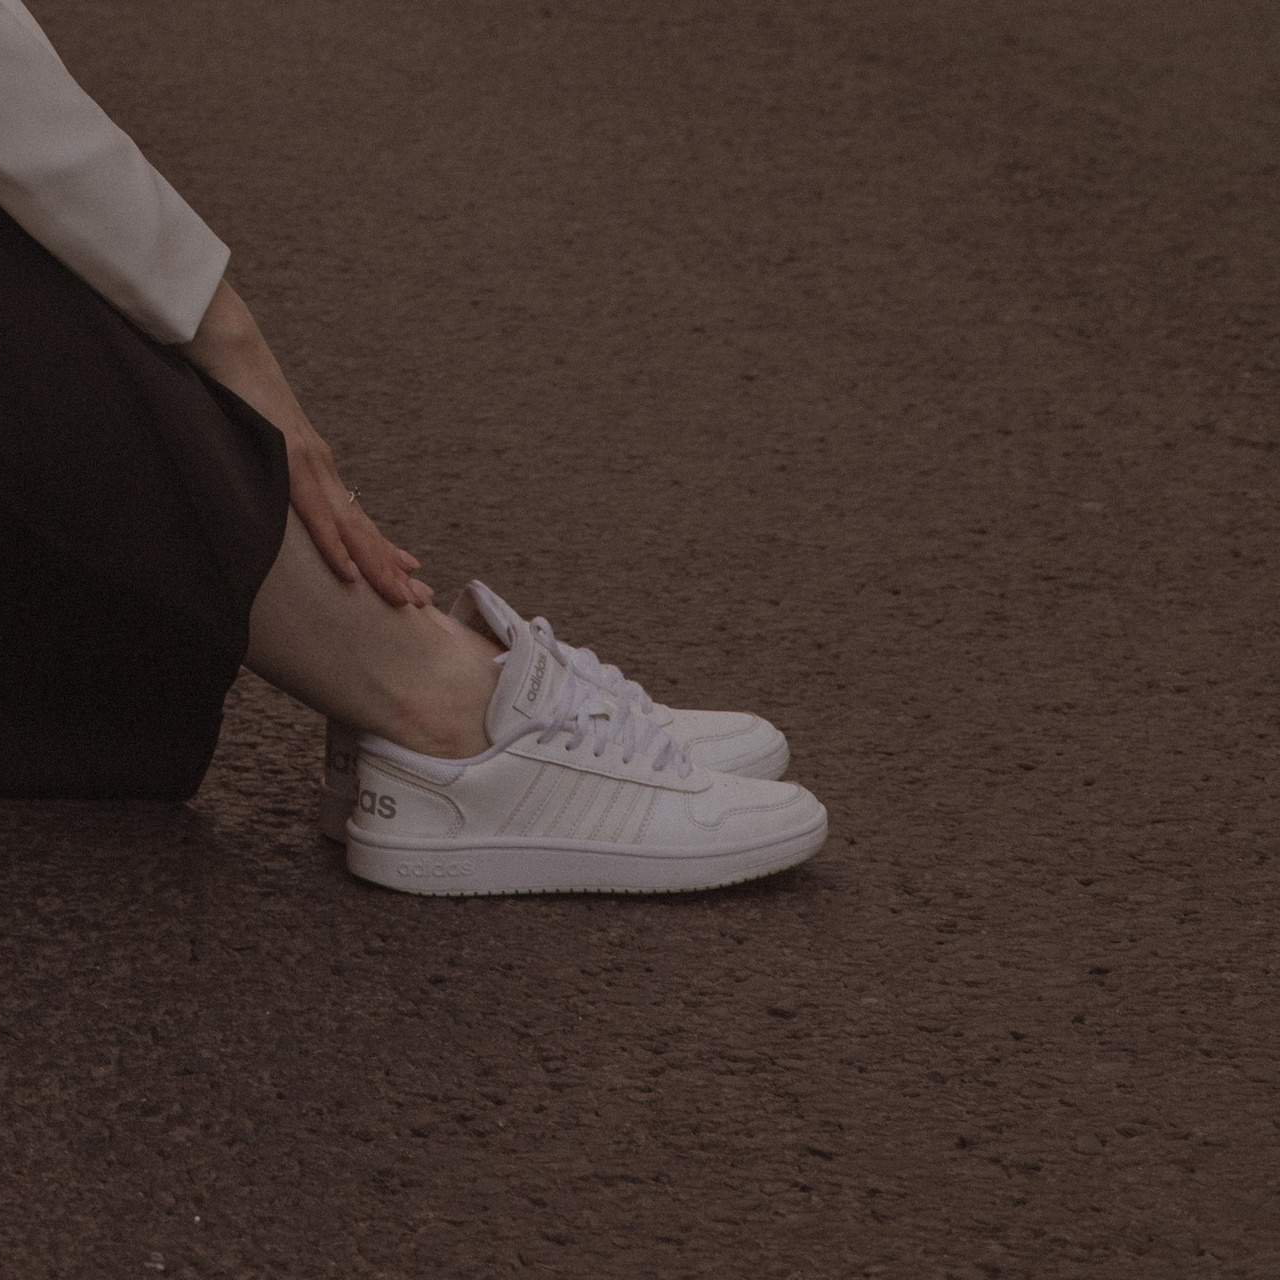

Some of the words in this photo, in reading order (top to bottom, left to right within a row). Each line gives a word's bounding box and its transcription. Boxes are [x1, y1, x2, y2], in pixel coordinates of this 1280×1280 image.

[527, 652, 547, 702] adidas
[357, 779, 397, 819] as
[396, 859, 475, 879] adidas
